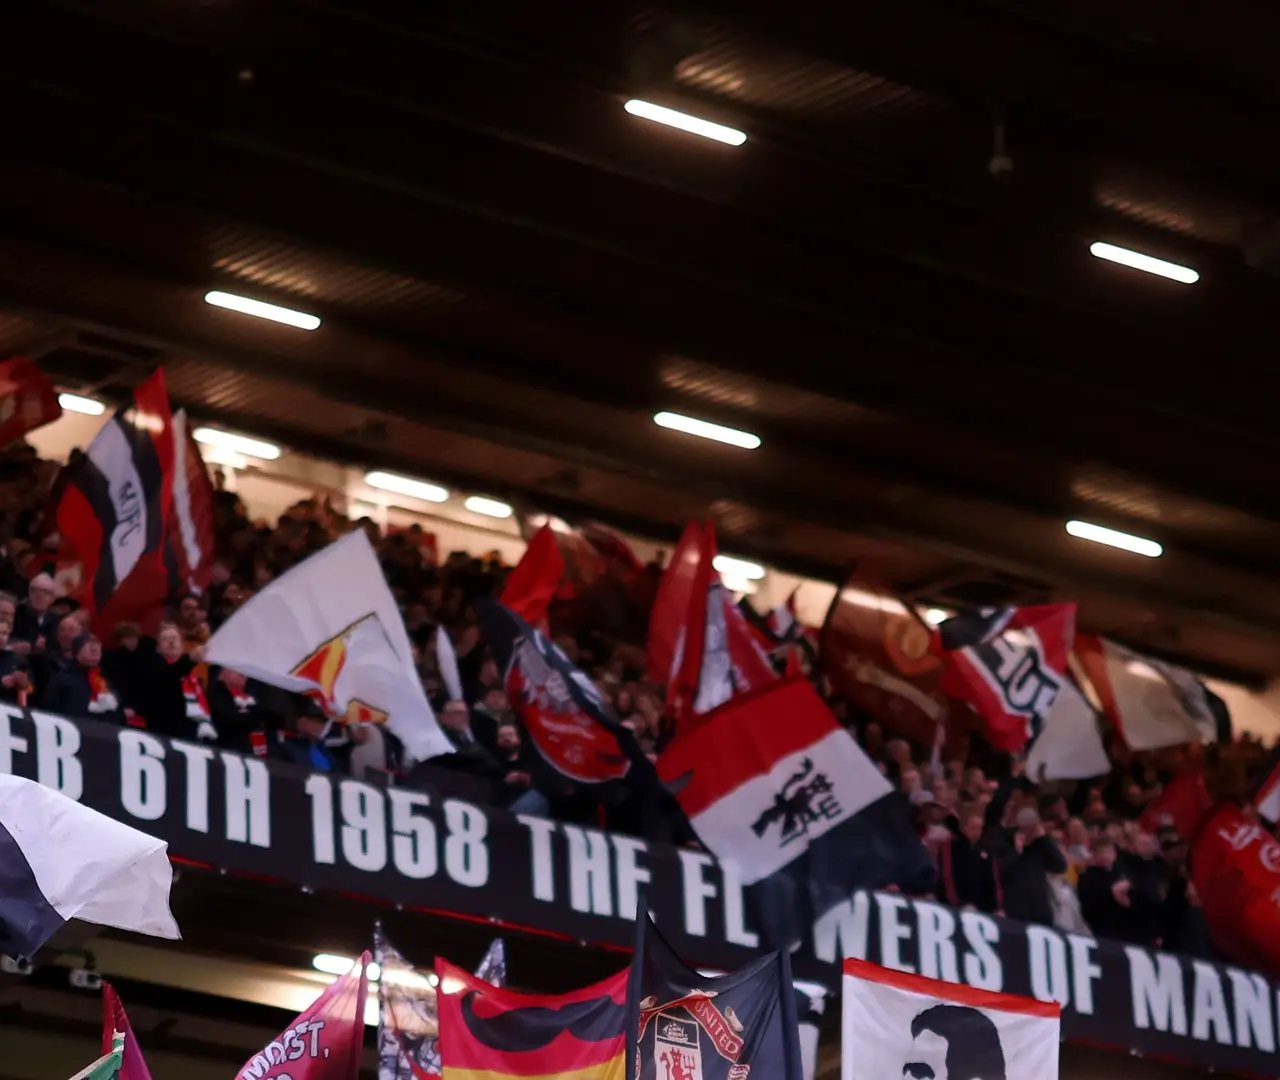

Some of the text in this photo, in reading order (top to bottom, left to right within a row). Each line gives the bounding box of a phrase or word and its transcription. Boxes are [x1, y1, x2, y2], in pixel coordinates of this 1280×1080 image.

[119, 728, 271, 849] 6TH
[305, 773, 490, 888] 1958
[517, 813, 655, 922] THE
[678, 848, 1003, 993] FLWERS
[1026, 924, 1102, 1016] OF
[695, 1000, 740, 1055] UNITED
